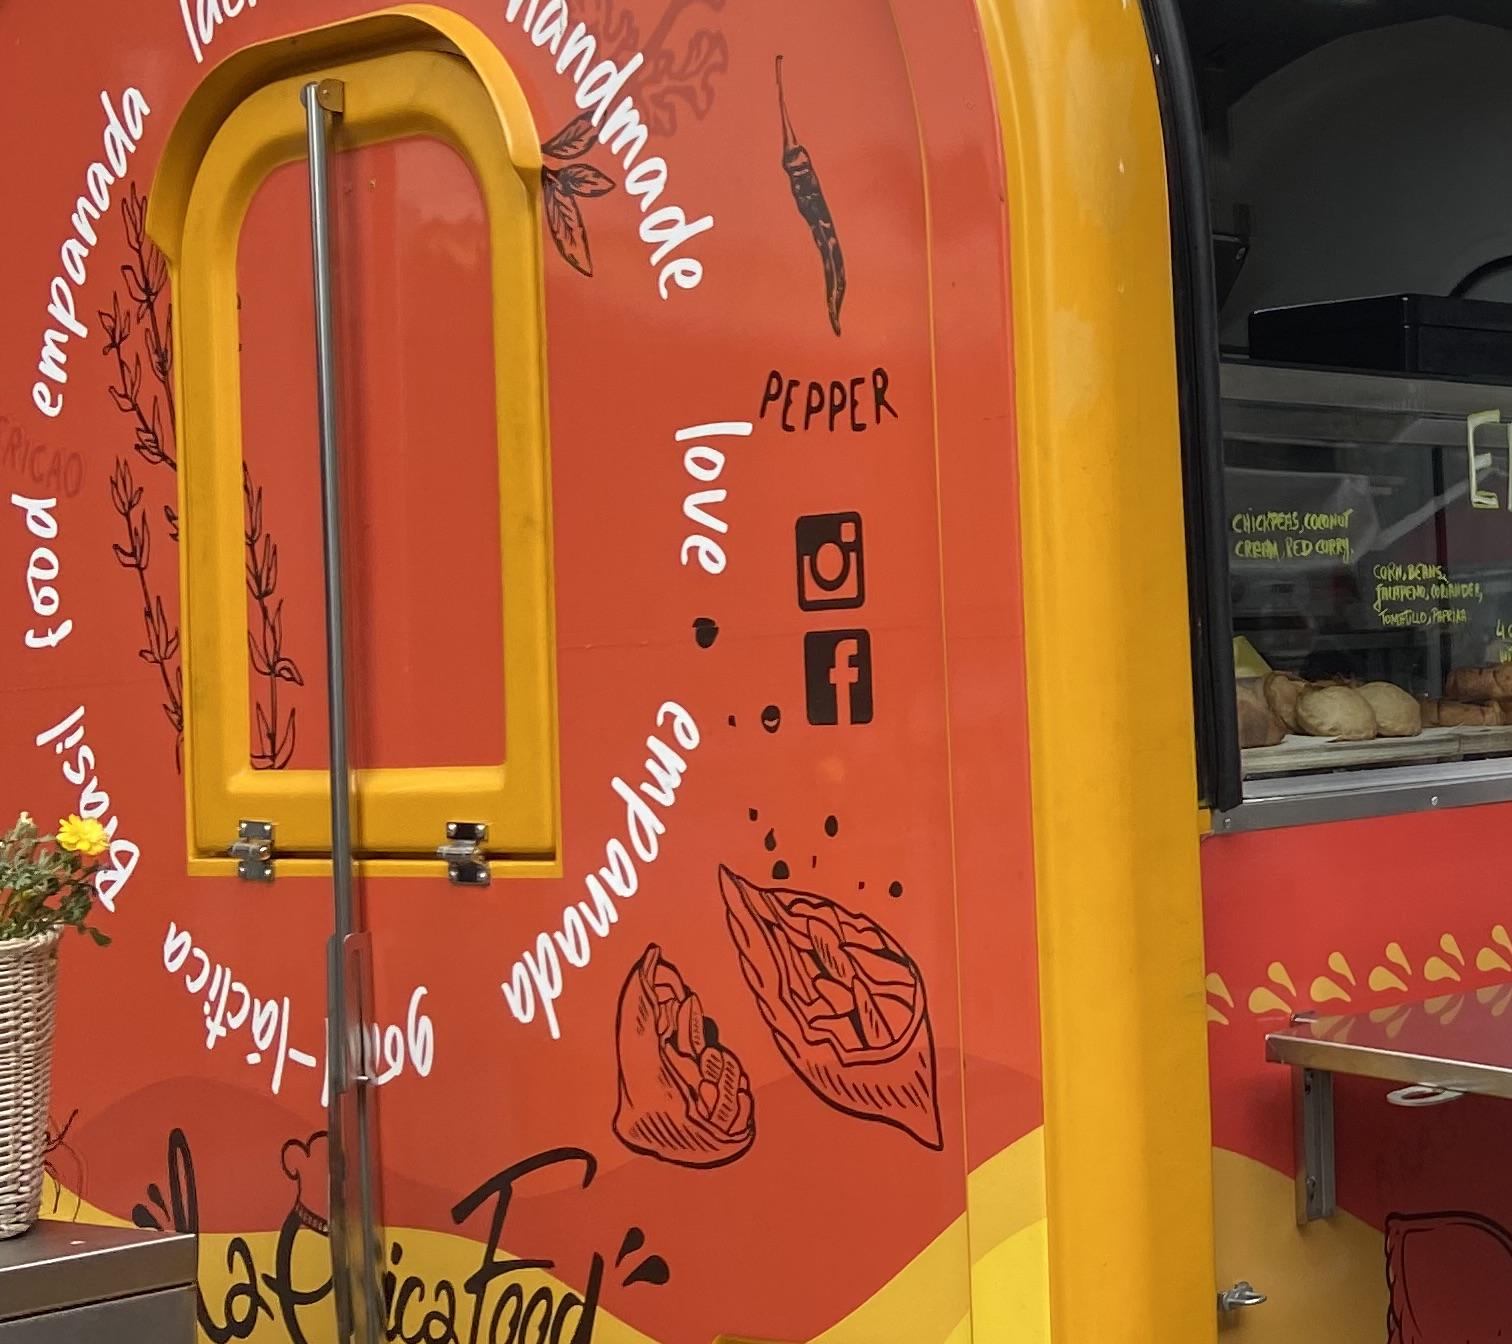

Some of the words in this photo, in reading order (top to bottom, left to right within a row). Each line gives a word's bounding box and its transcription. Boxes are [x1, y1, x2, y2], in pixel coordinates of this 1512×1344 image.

[31, 86, 152, 418] empanada
[759, 367, 898, 433] PEPPER
[11, 493, 73, 648] food
[675, 421, 753, 575] love
[1286, 536, 1313, 558] RED
[1496, 619, 1505, 640] 4
[501, 701, 700, 1040] empanada
